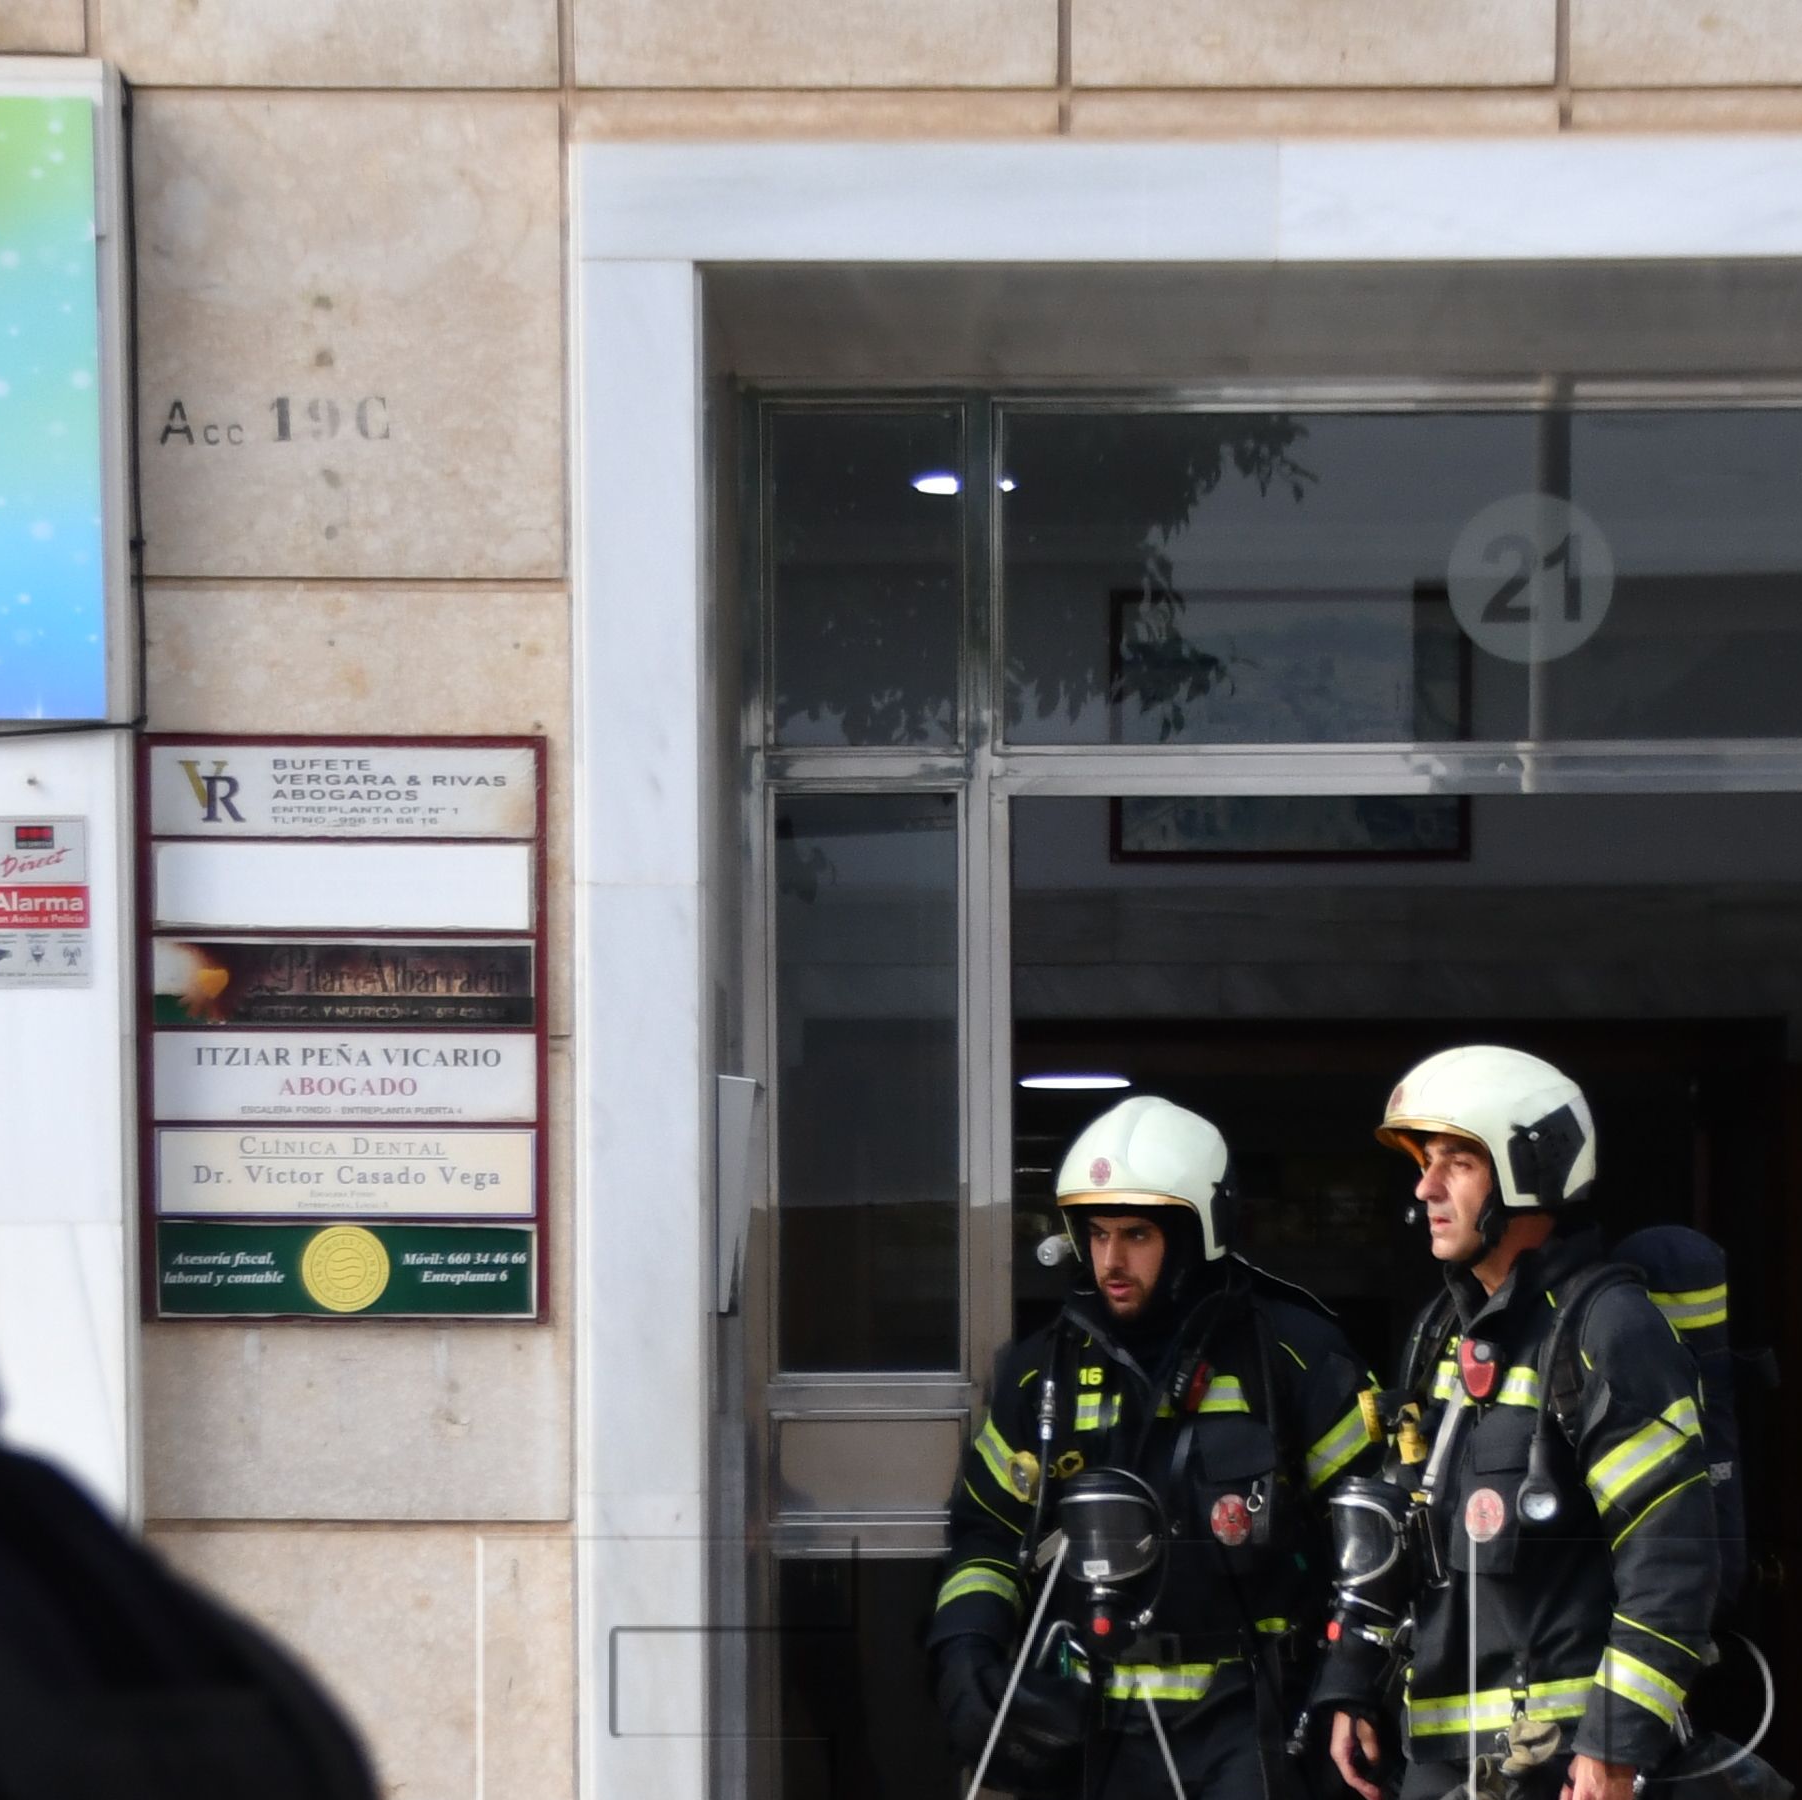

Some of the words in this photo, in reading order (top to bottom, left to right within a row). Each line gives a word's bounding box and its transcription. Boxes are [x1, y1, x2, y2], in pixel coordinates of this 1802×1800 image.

[160, 399, 244, 446] Acc
[1480, 534, 1583, 624] 21
[271, 758, 372, 772] BUFETE
[271, 773, 397, 787] VERGARA
[406, 774, 423, 787] &
[431, 774, 508, 788] RIVAS
[271, 788, 419, 802] ABOGADOS
[270, 805, 394, 815] ENTREPLANTA
[196, 1046, 292, 1069] ITZIAR
[300, 1043, 373, 1068] PEÑA
[381, 1047, 503, 1069] VICARIO
[278, 1076, 419, 1097] ABOGADO
[192, 1165, 233, 1185] Dr.
[336, 1165, 428, 1186] Casado
[439, 1166, 502, 1190] Vega
[172, 1252, 234, 1267] Asesoría
[401, 1251, 445, 1267] Móvil:
[446, 1252, 471, 1266] 660
[472, 1252, 492, 1266] 34
[492, 1252, 508, 1266] 46
[508, 1252, 528, 1266] 66
[163, 1270, 212, 1285] laboral
[212, 1274, 225, 1287] y
[225, 1270, 286, 1285] contable
[420, 1270, 499, 1286] Entreplanta
[499, 1270, 510, 1285] 6
